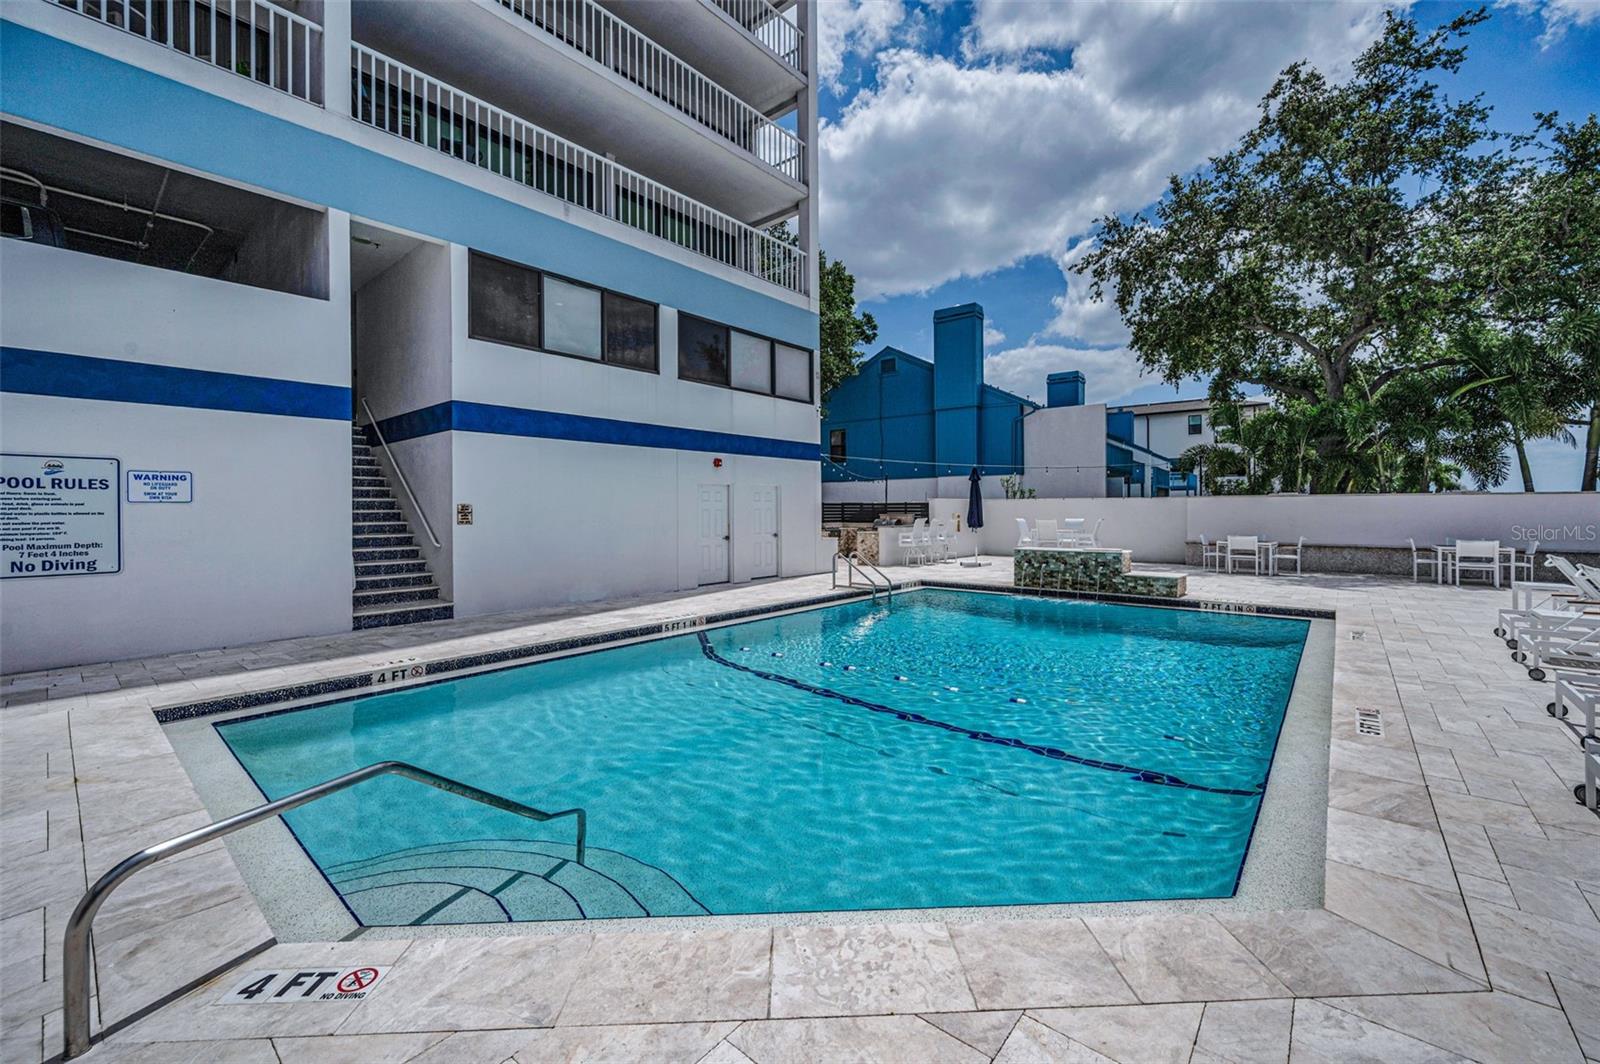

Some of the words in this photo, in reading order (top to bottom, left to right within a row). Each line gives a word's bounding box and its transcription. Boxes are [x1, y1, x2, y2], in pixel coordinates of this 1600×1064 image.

[51, 478, 110, 490] RULES
[10, 561, 36, 573] No
[41, 559, 98, 572] Diving
[664, 624, 670, 632] 5
[672, 622, 679, 631] FT
[378, 672, 386, 683] 4
[392, 669, 407, 681] FT
[237, 974, 278, 1000] 4
[273, 972, 338, 997] FT
